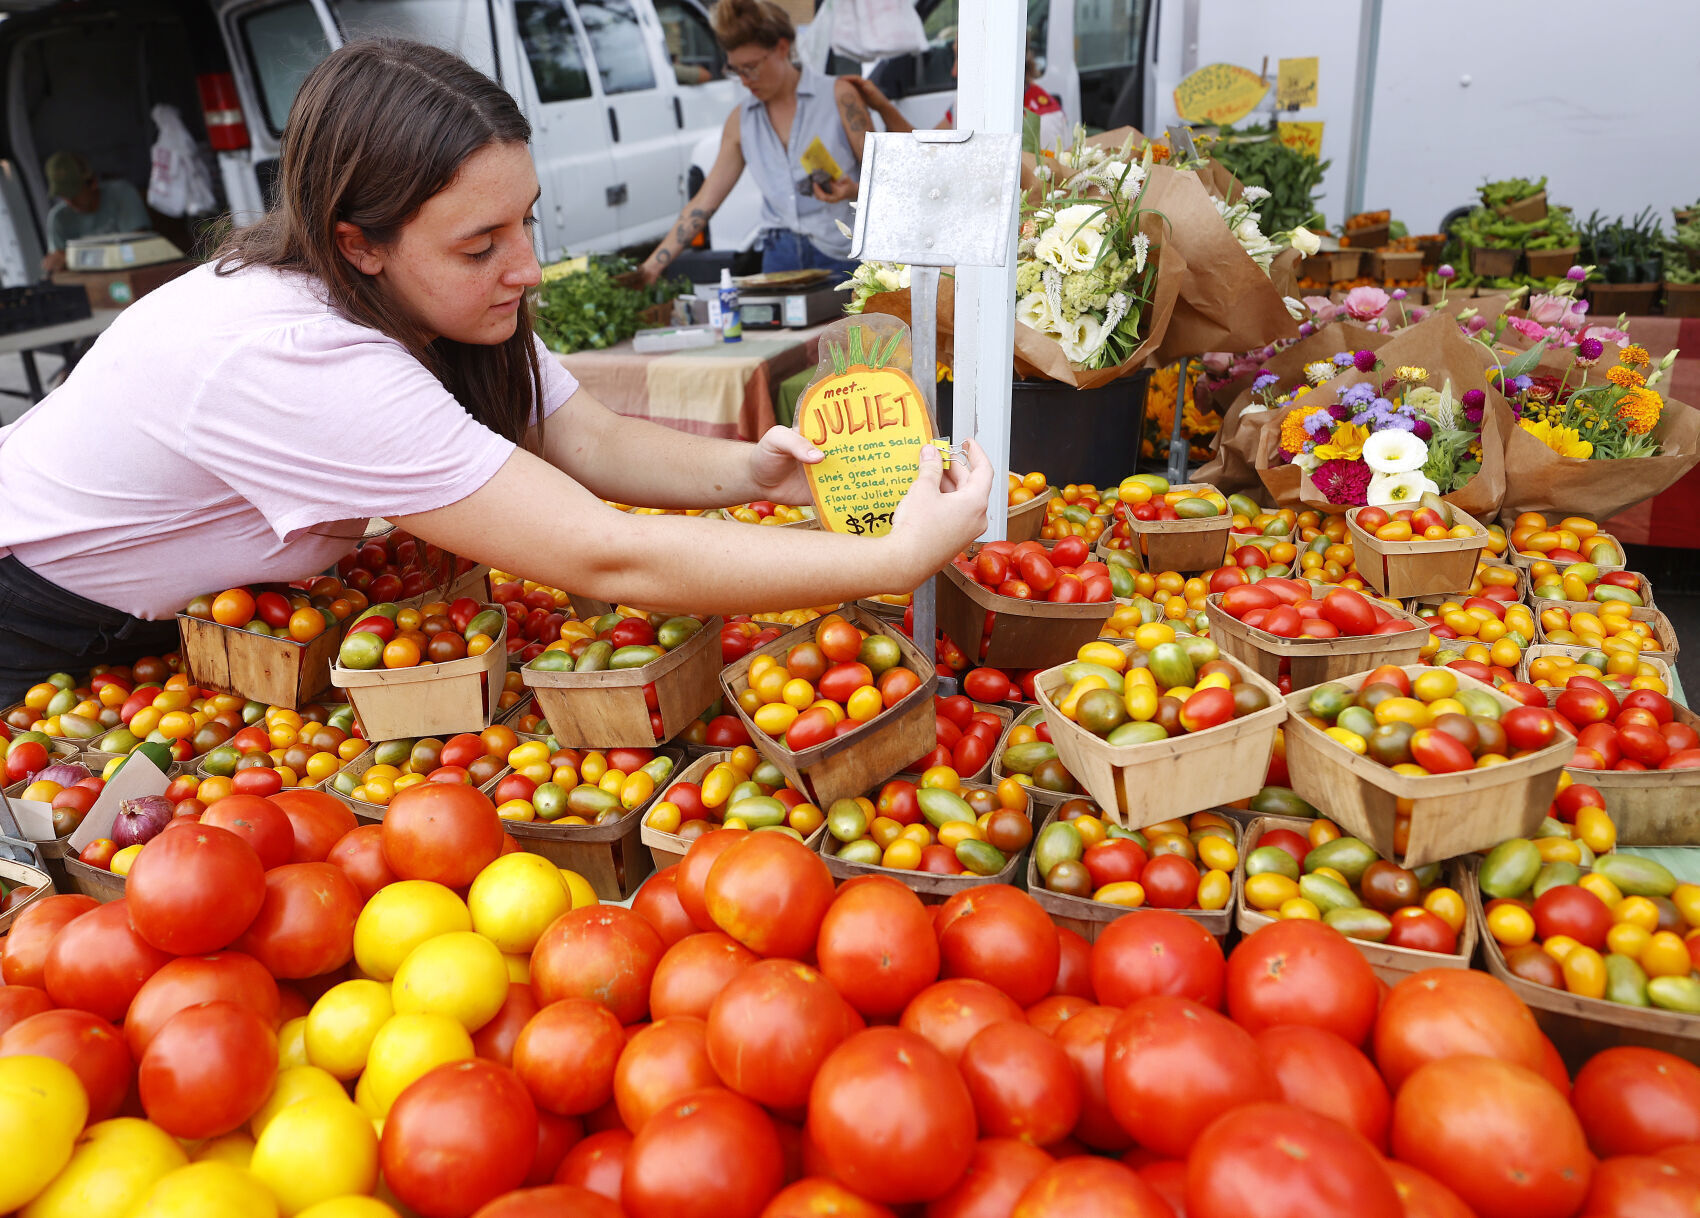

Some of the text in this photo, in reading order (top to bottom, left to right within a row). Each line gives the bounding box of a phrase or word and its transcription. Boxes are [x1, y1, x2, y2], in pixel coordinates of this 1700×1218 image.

[812, 392, 912, 446] JULIET
[823, 436, 921, 460] petite roma salad
[840, 451, 891, 465] TOMATO
[848, 467, 877, 484] great
[882, 466, 893, 474] in
[895, 463, 920, 473] sals
[855, 478, 889, 489] salad,
[890, 476, 913, 485] nice
[861, 489, 894, 500] Juliet
[833, 504, 848, 513] let
[850, 505, 869, 513] you
